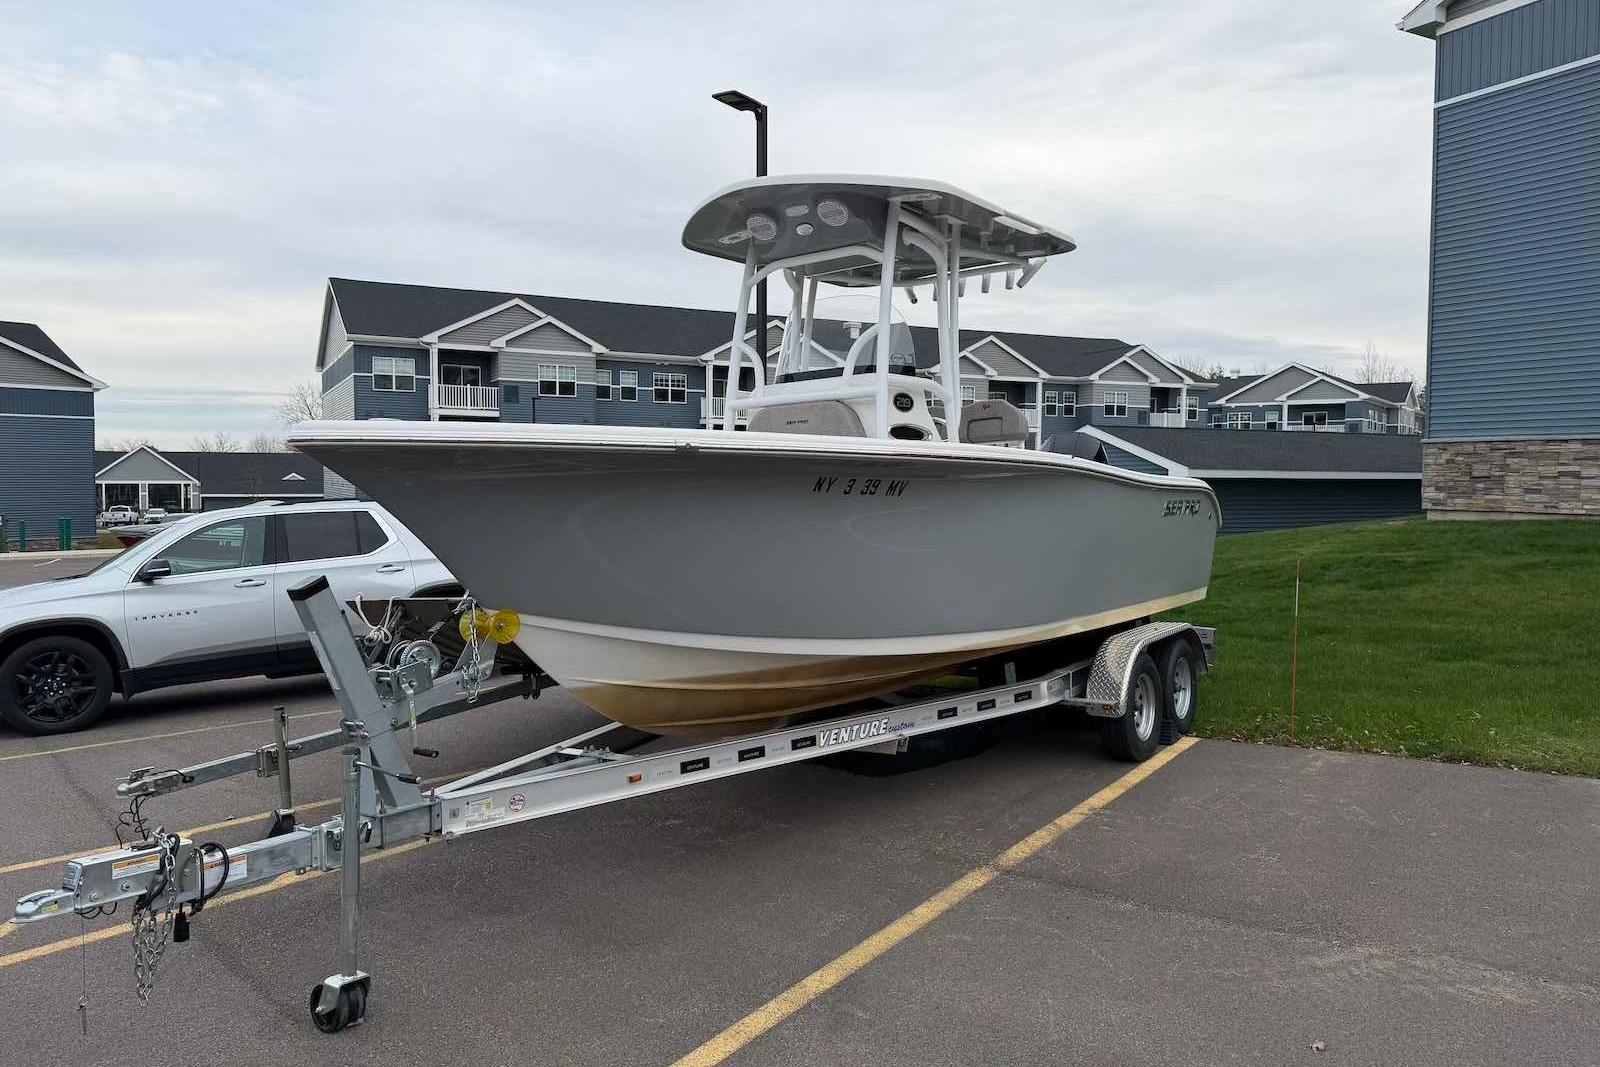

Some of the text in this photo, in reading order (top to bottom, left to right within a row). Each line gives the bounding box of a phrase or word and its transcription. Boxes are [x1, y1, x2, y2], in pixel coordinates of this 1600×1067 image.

[812, 476, 910, 497] NY 3 39 MV
[1162, 499, 1201, 517] SEA PRO
[135, 609, 199, 621] TRAVERSE
[819, 718, 889, 748] VENTURE
